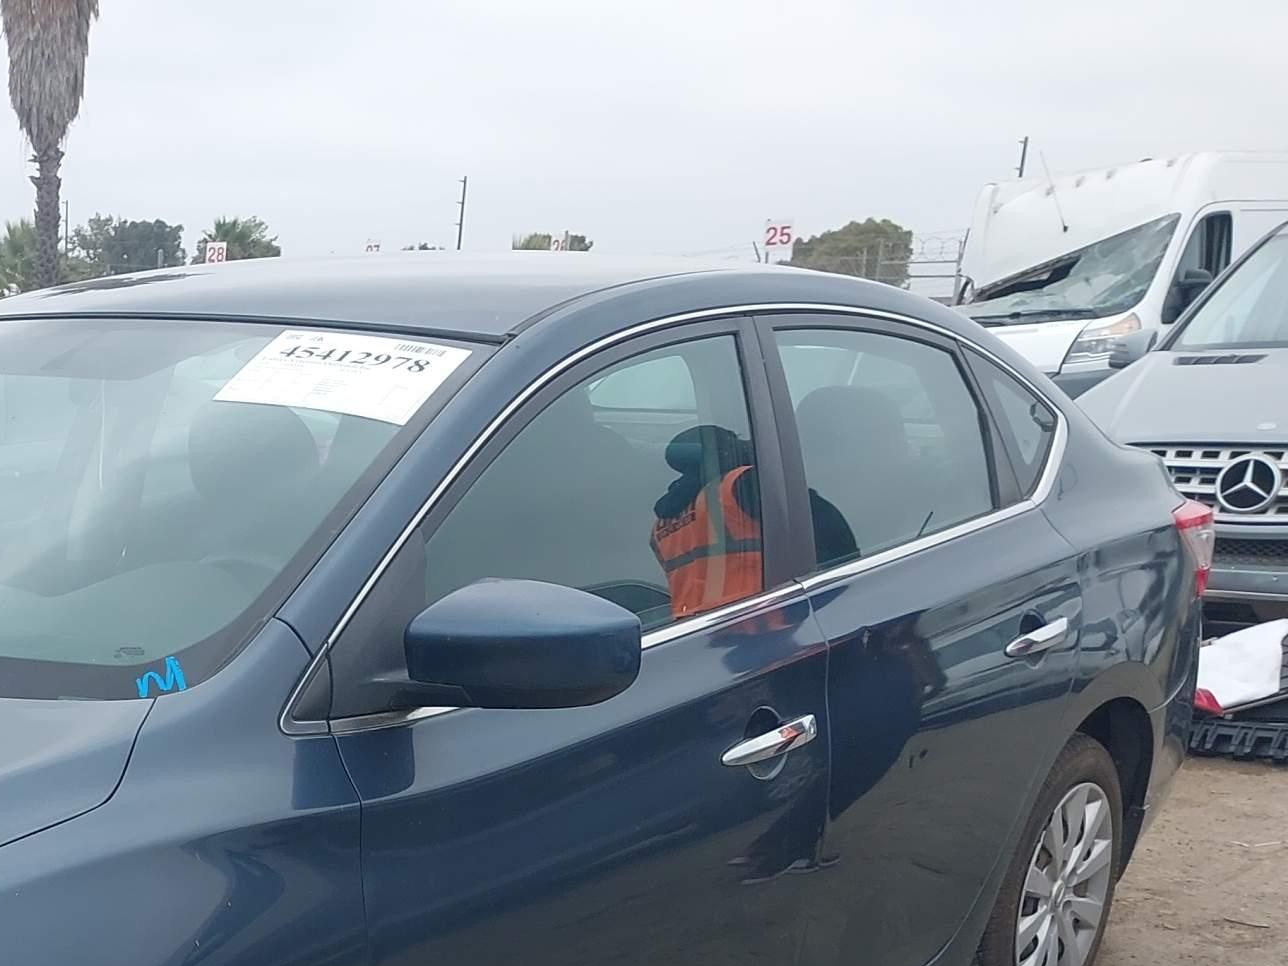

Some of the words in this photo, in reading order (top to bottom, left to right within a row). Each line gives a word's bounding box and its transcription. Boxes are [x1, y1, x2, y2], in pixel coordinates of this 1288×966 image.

[765, 226, 792, 246] 25
[208, 247, 224, 263] 28
[279, 345, 431, 373] 45412978
